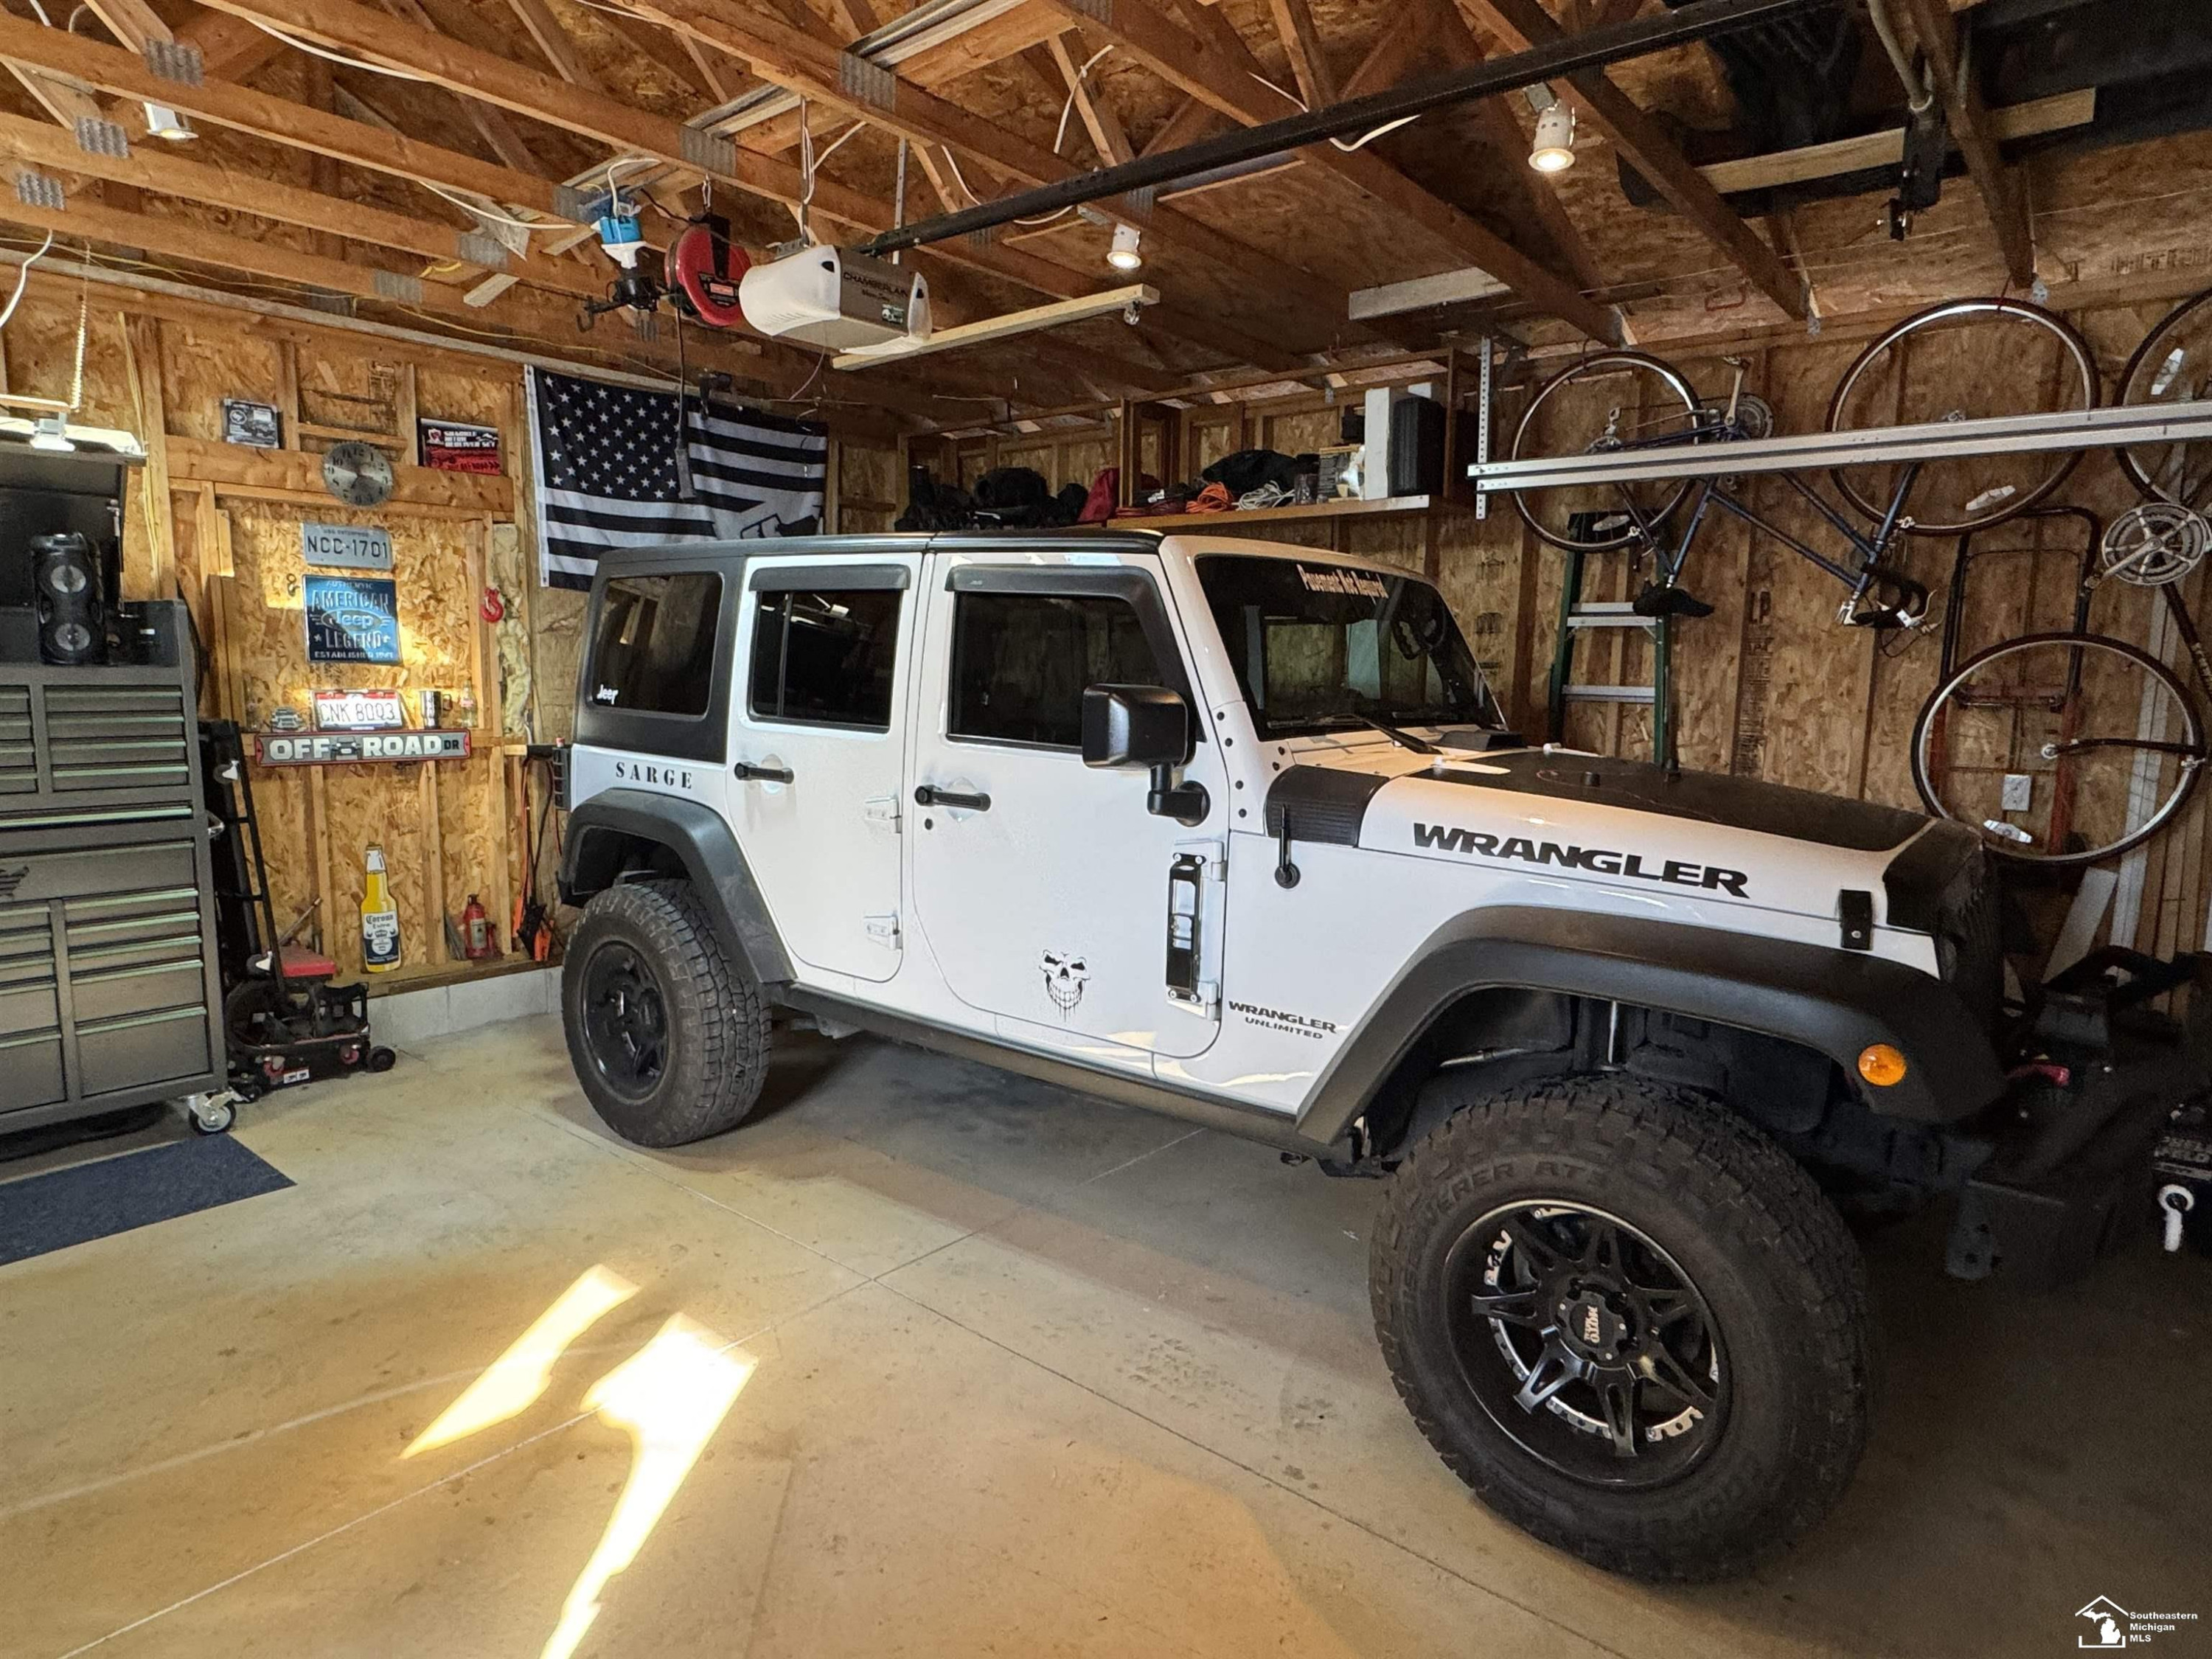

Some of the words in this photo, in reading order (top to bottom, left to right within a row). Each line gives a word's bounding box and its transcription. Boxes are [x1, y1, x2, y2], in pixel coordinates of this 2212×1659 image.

[307, 535, 388, 559] NCC-1701
[311, 590, 389, 615] AMERICAN
[329, 611, 375, 629] Jeep
[325, 628, 382, 649] LEGEND
[597, 684, 619, 705] Jeep
[319, 703, 351, 722] CNK
[269, 738, 330, 760] OFF
[362, 736, 442, 757] ROAD
[444, 740, 459, 750] DR
[616, 762, 692, 789] SARGE
[1413, 822, 1750, 899] WRANGLER
[1228, 1001, 1337, 1034] WRANGLER
[1245, 1017, 1324, 1040] UNLIMITED
